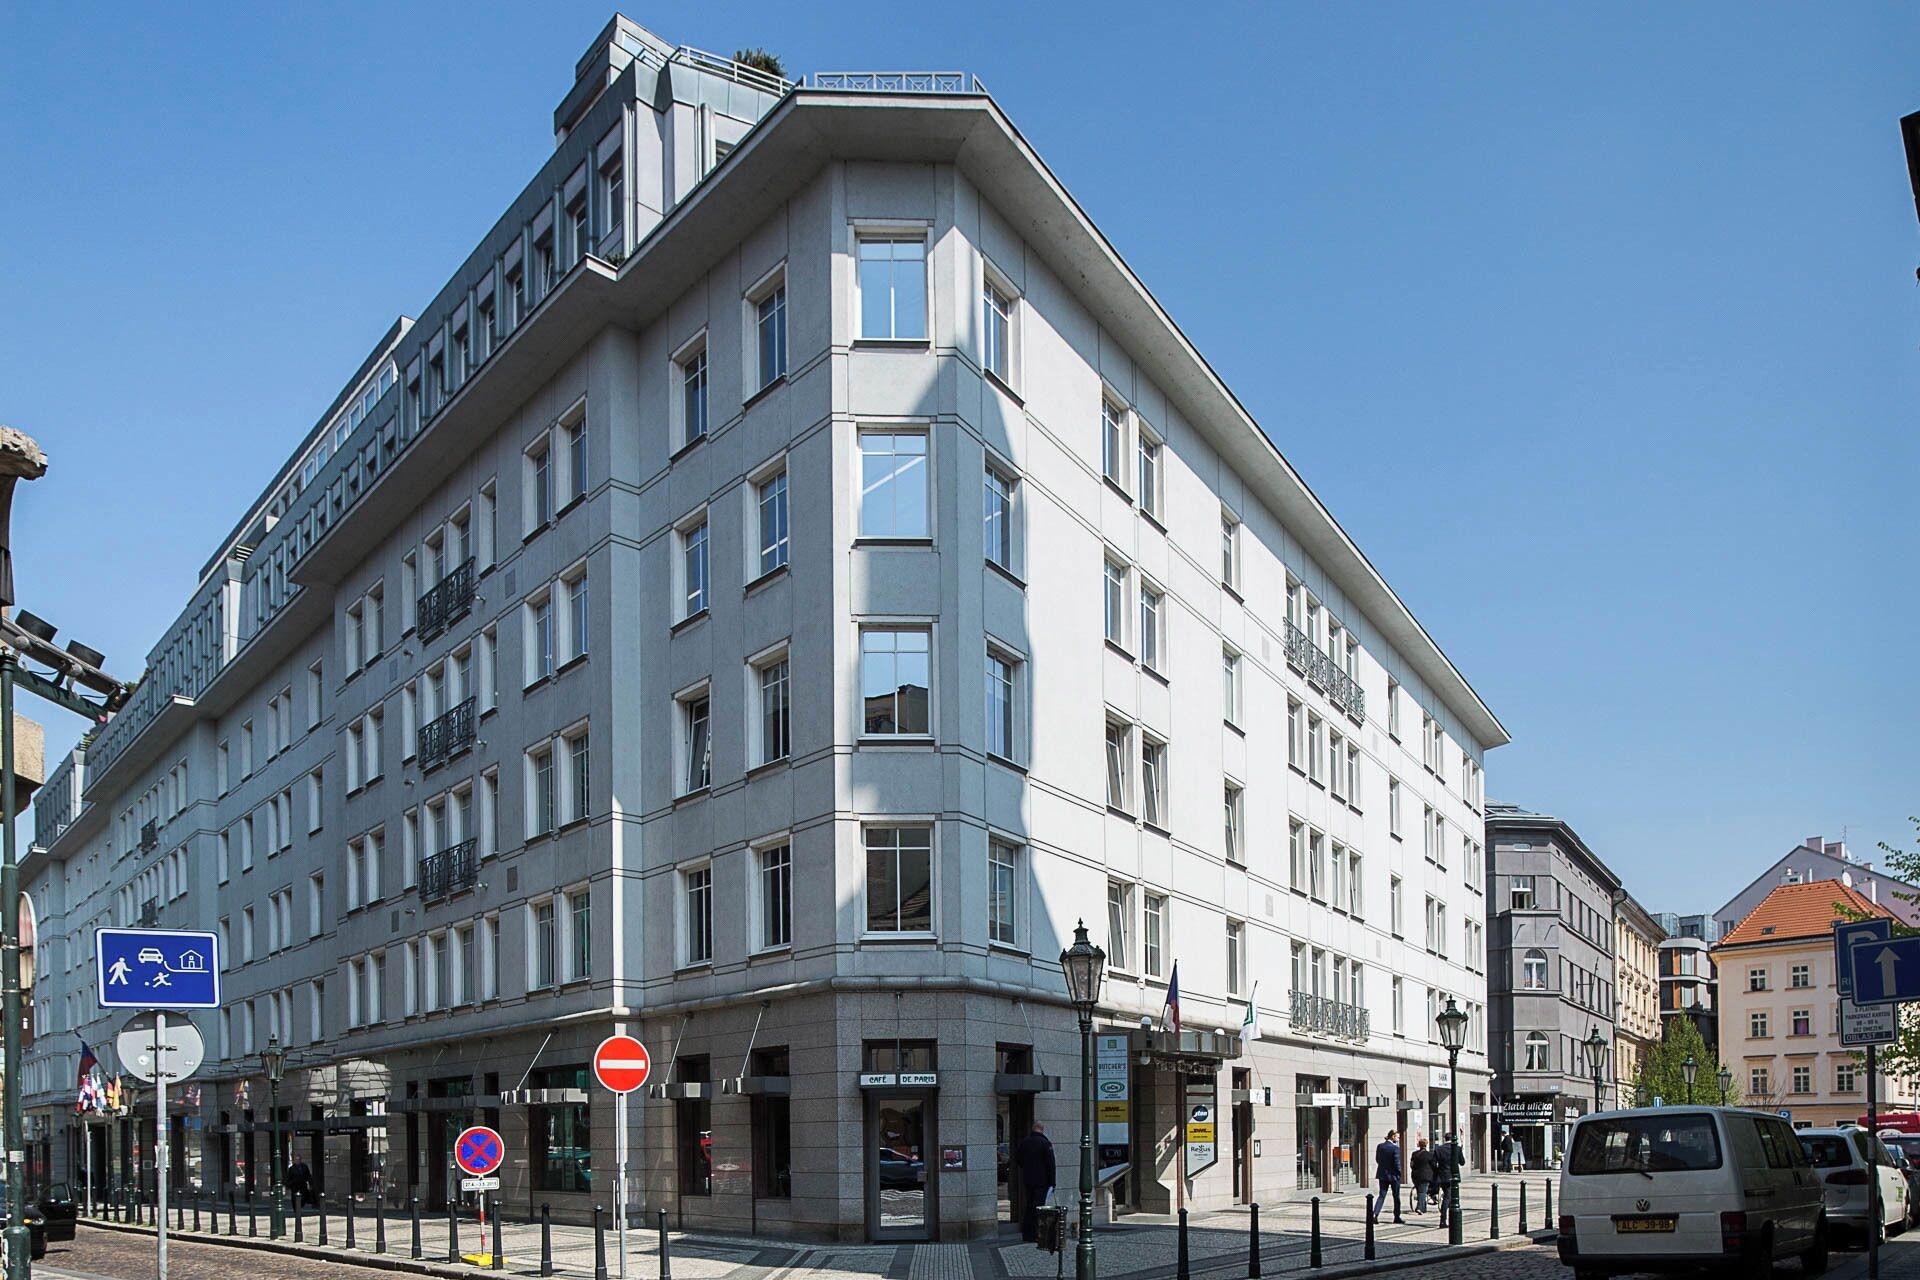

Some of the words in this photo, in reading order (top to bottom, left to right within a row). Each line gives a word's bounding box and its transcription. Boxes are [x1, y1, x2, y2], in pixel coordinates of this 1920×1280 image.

[1847, 1032, 1875, 1041] OBLAST
[869, 1074, 887, 1084] CAFÉ
[914, 1076, 935, 1084] PARIS
[1503, 1101, 1525, 1111] Zlatá
[1527, 1101, 1552, 1111] ulička
